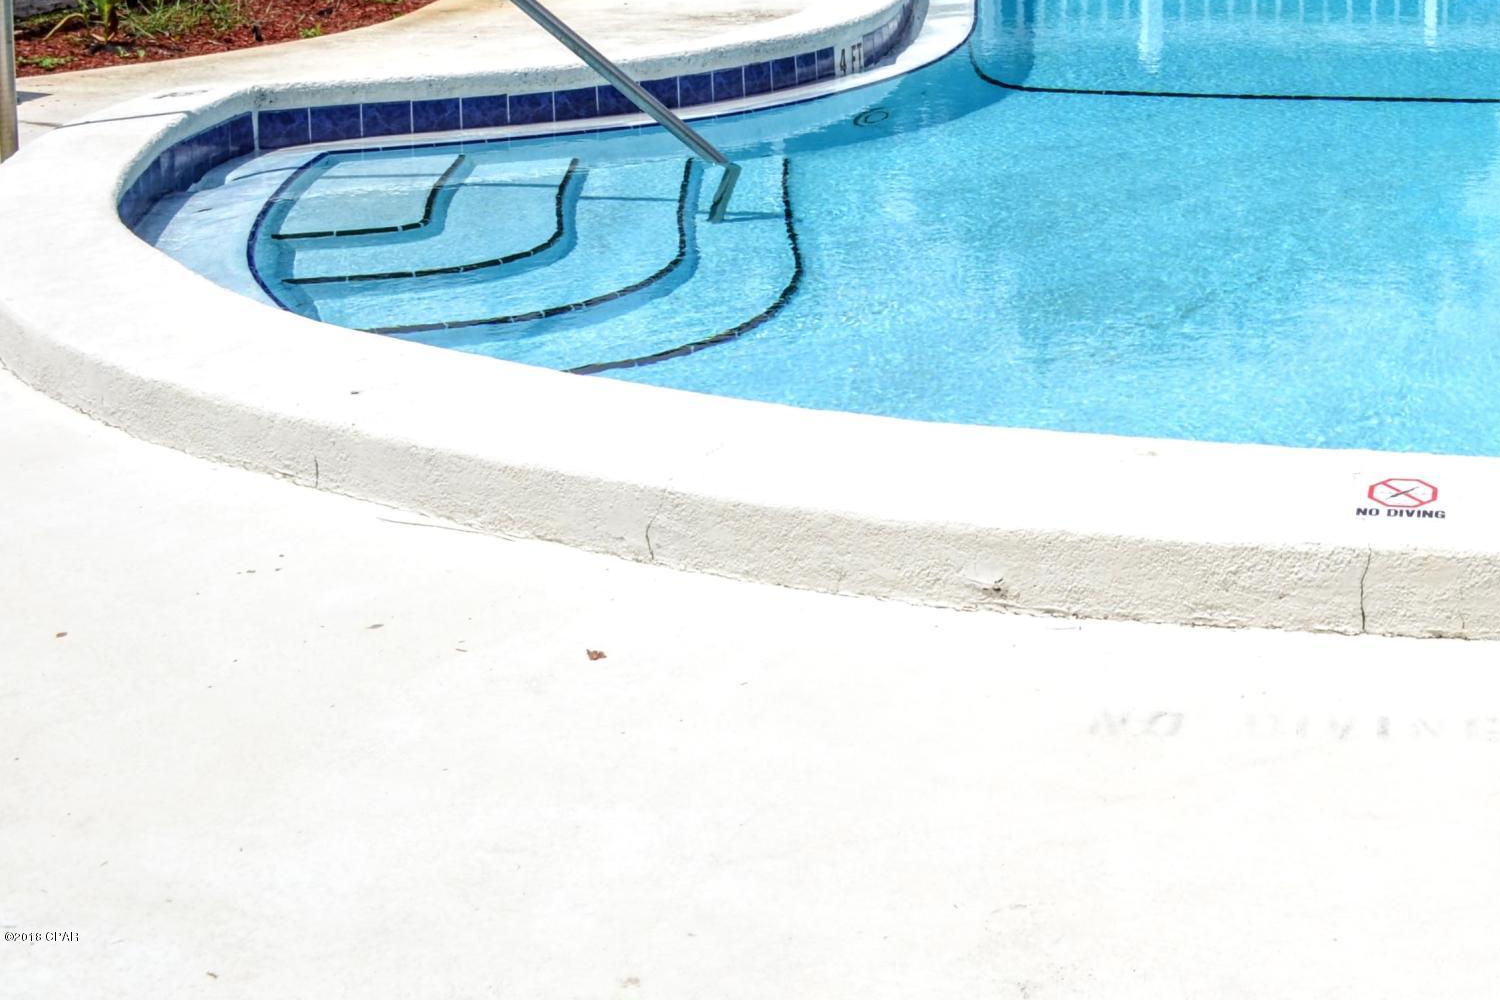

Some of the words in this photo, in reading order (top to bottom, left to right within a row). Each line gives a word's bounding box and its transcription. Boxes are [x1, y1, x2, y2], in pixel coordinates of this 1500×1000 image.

[839, 47, 848, 77] 4
[1355, 507, 1380, 517] NO
[1386, 508, 1446, 519] DIVING
